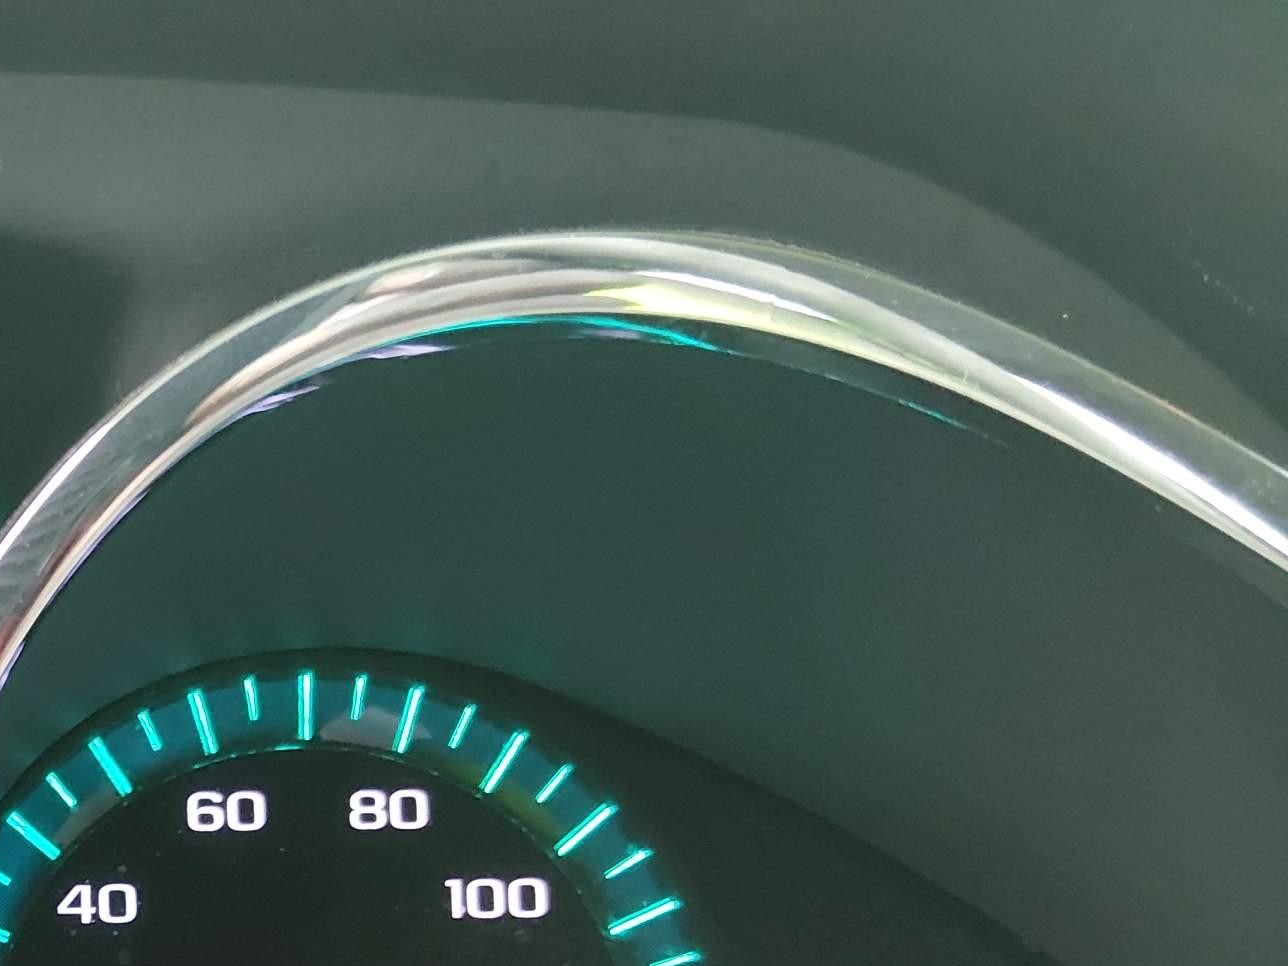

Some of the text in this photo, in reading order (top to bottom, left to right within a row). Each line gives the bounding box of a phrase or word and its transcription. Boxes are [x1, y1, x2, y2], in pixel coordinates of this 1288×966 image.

[186, 790, 267, 831] 60
[348, 789, 429, 830] 80
[57, 883, 137, 923] 40
[445, 878, 550, 918] 100
